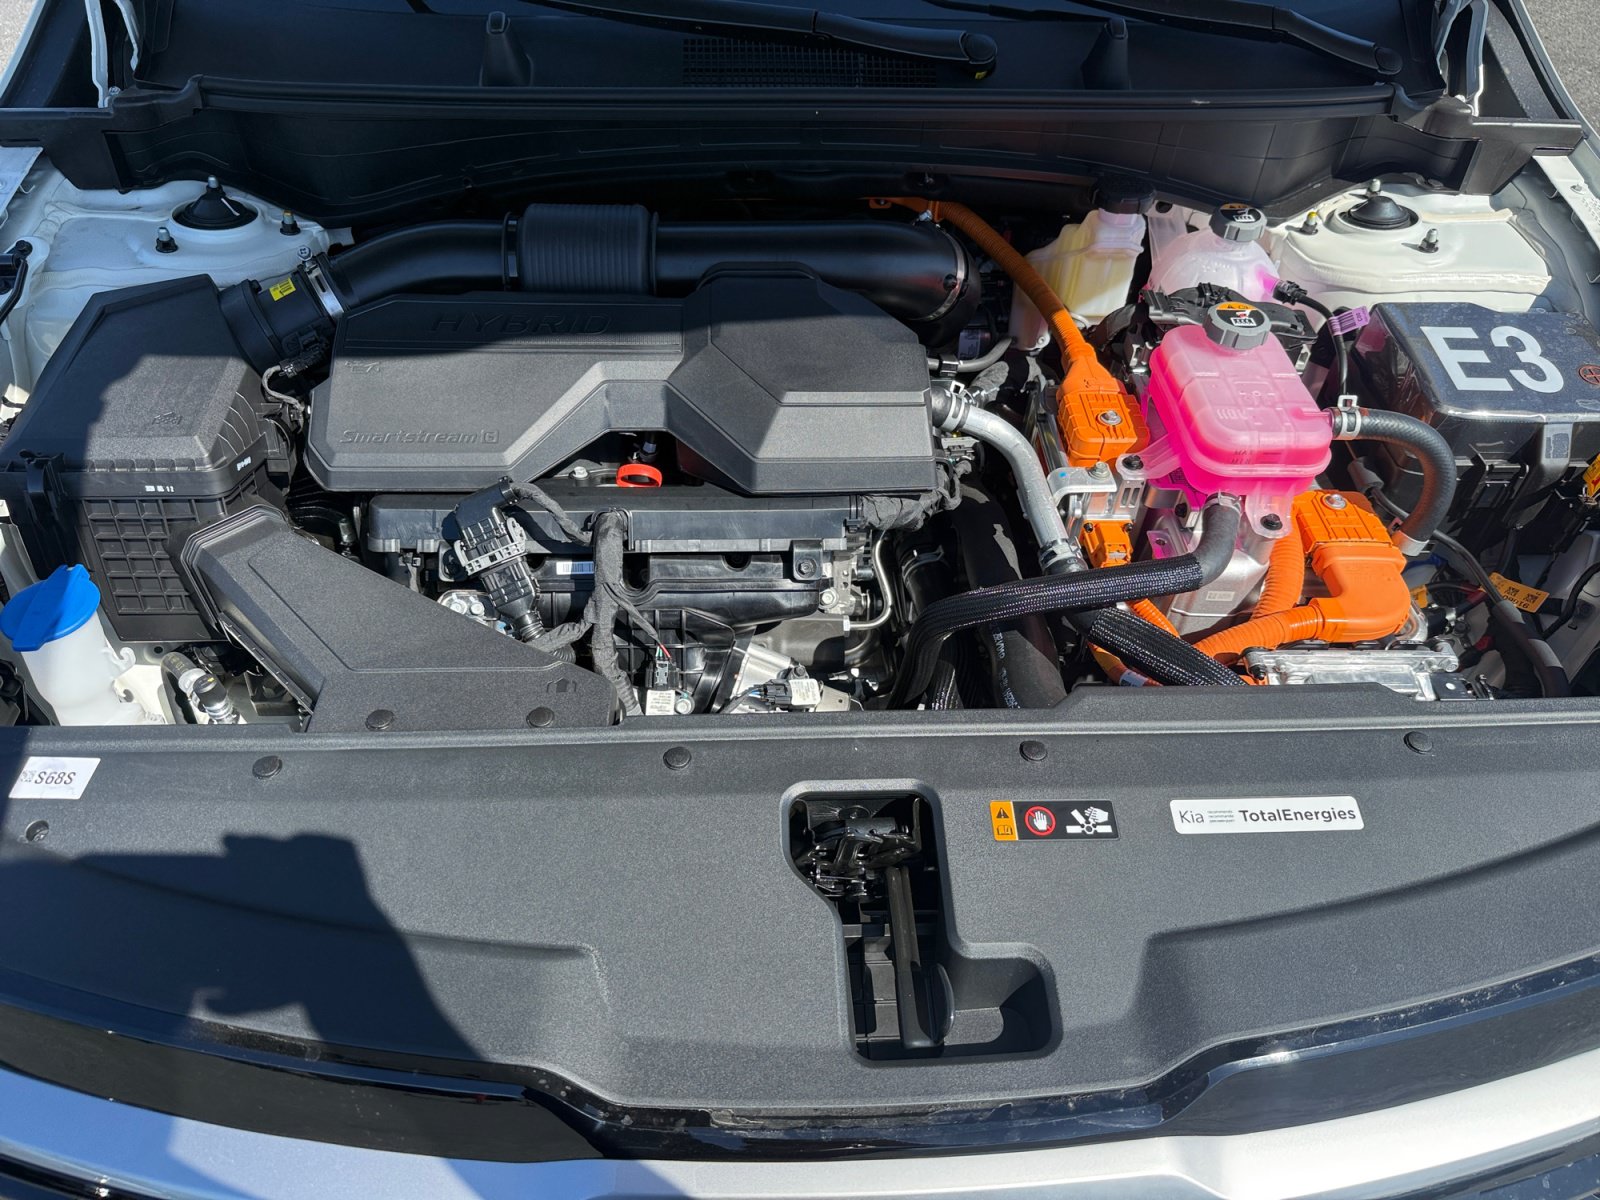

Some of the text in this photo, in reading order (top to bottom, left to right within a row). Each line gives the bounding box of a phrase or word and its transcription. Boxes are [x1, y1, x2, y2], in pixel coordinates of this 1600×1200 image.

[429, 312, 612, 335] HYBRID
[1419, 325, 1565, 394] E3
[339, 429, 478, 444] Smartstream
[34, 771, 76, 785] S68S
[1178, 806, 1357, 824] Kia TotalEnergies
